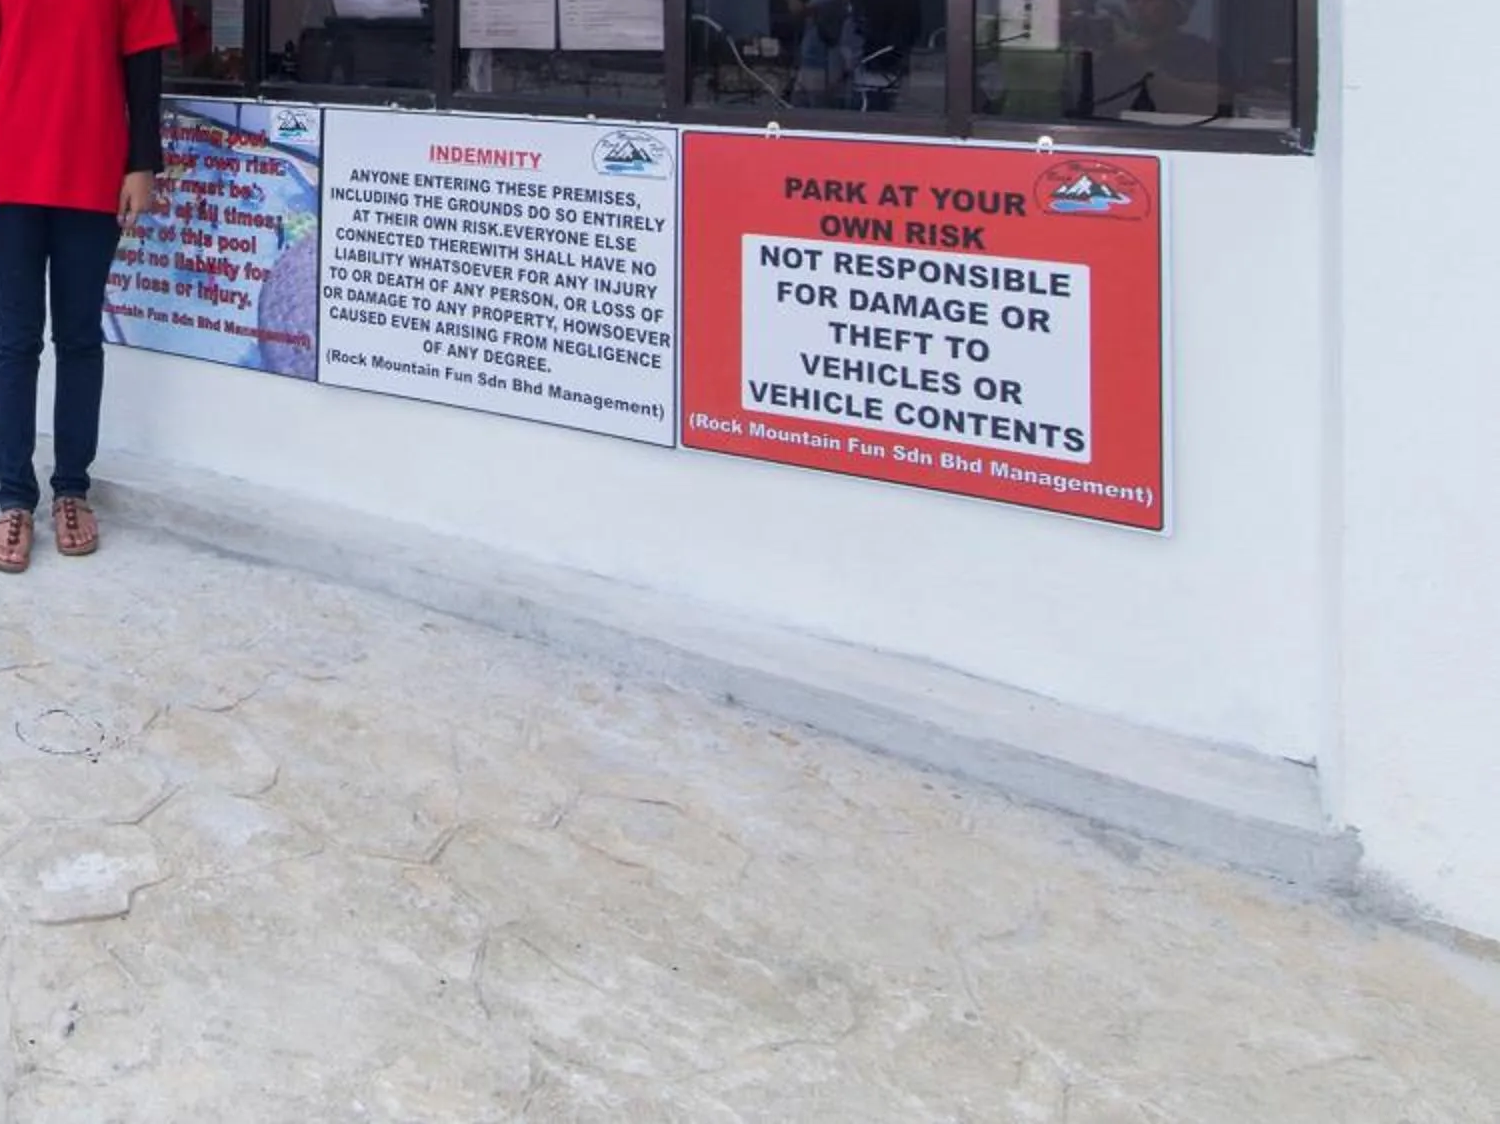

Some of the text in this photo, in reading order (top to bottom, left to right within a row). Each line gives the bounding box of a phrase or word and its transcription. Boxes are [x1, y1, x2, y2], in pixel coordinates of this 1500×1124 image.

[429, 145, 542, 169] INDEMNITY
[331, 188, 665, 232] INCLUDING THE GROUNDS DO SO ENTIRELY
[351, 169, 641, 209] ANYONE ENTERING THESE PREMISES,
[785, 177, 1026, 216] PARK AT YOUR
[218, 236, 256, 254] pool
[336, 228, 656, 276] CONNECTED THEREWITH SHALL HAVE NO
[352, 211, 636, 252] AT THEIR OWN RISK.EVERYONE ELSE
[820, 215, 985, 249] OWN RISK
[149, 252, 169, 267] no
[335, 248, 657, 300] LIABILITY WHATSOEVER FOR ANY INJURY
[761, 245, 1071, 297] NOT RESPONSIBLE
[175, 281, 192, 297] or
[330, 266, 664, 323] TO OR DEATH OF ANY PERSON, OR LOSS OF
[778, 282, 1050, 332] FOR DAMAGE OR
[324, 286, 671, 348] OR DAMAGE TO ANY PROPERTY, HOWSOEVER
[330, 306, 661, 368] CAUSED EVEN ARISING FROM NEGLIGENCE
[423, 340, 551, 373] OF ANY DEGREE.
[829, 322, 989, 361] THEFT TO
[326, 349, 665, 421] (Rock Mountain Fun Sdn Bhd Management)
[801, 353, 1022, 405] VEHICLES OR
[749, 381, 1085, 452] VEHICLE CONTENTS
[689, 413, 1154, 506] (Rock Mountain Fun Sdn Bhd Management)
